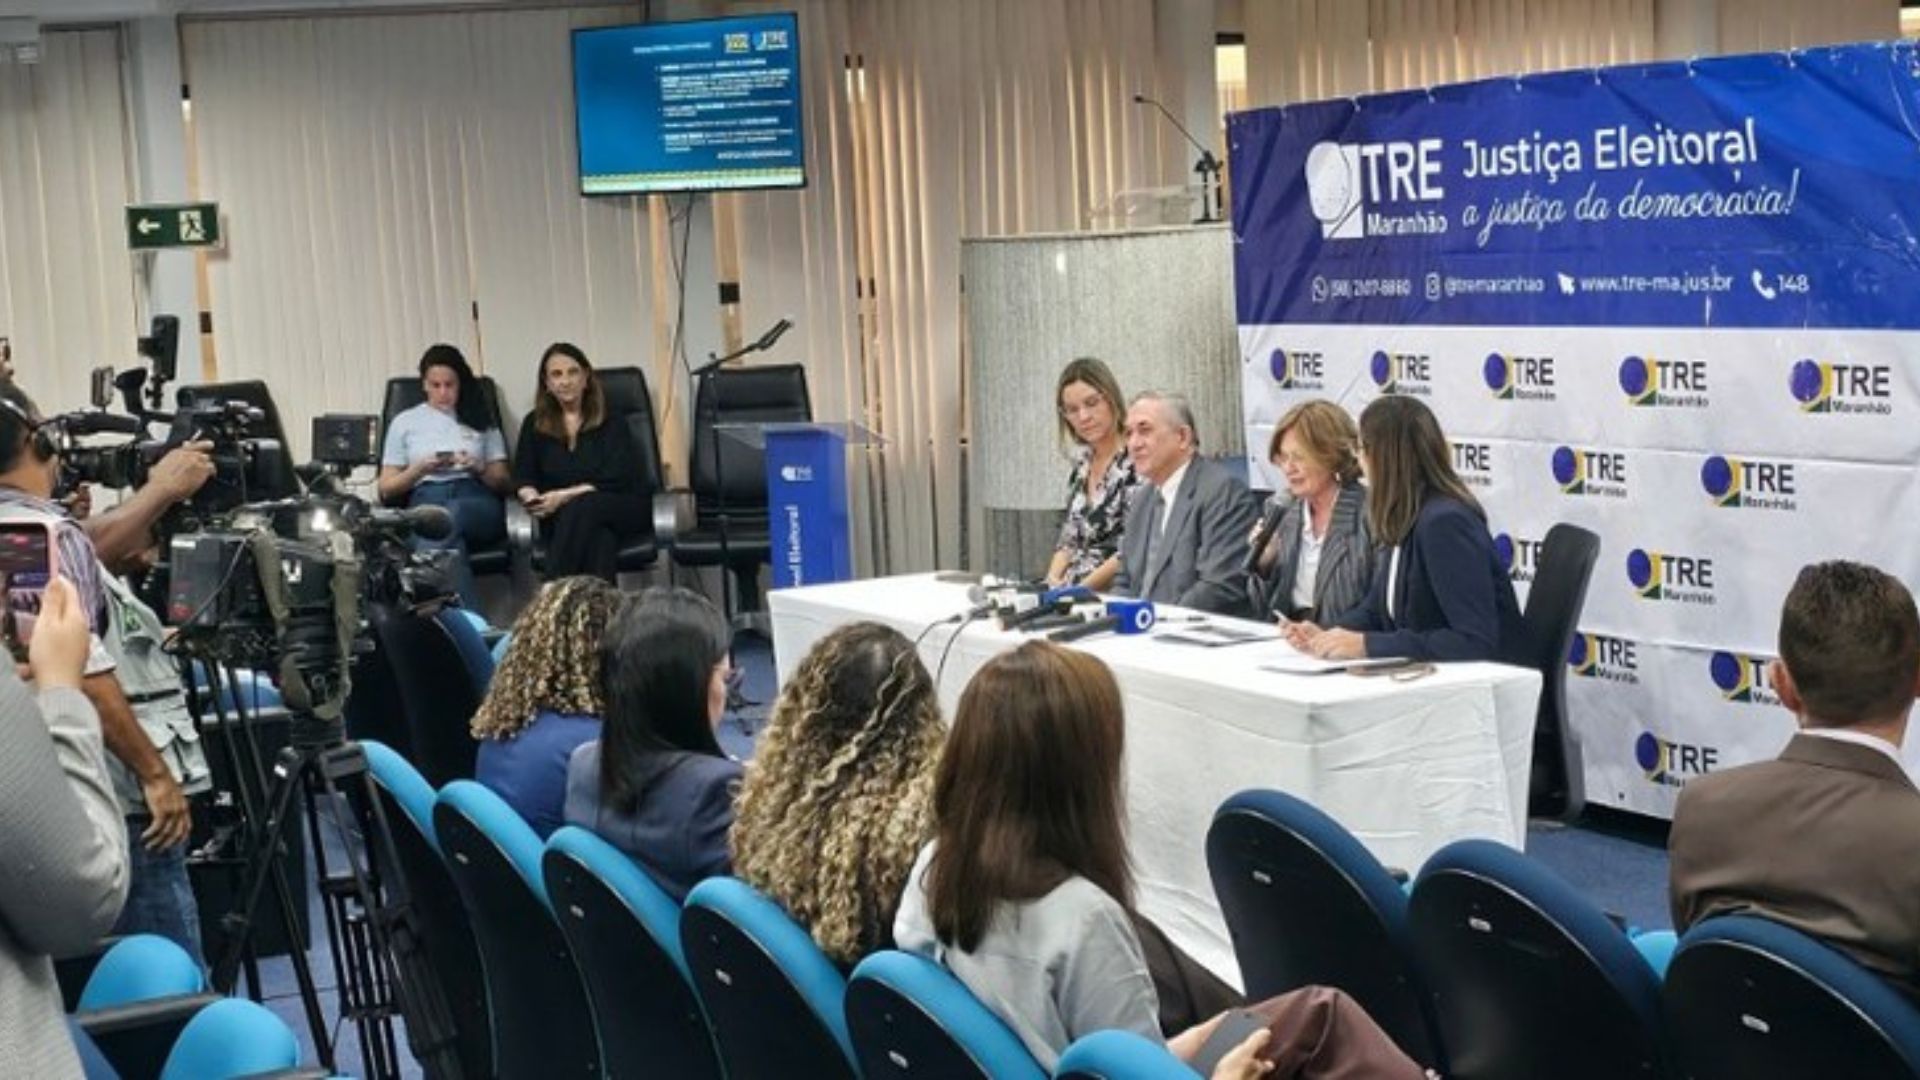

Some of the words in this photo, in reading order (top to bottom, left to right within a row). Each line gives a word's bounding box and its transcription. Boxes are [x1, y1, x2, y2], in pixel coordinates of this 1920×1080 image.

[1463, 130, 1582, 183] Justiça
[1594, 116, 1757, 170] Eleitoral
[1362, 138, 1444, 203] TRE
[1462, 205, 1480, 228] a
[1477, 190, 1566, 248] justiça
[1574, 180, 1612, 220] da
[1618, 168, 1800, 219] democracia!
[1367, 211, 1448, 236] Maranhão
[1581, 270, 1733, 294] www.tre-ma.jus.br
[1777, 274, 1810, 292] 148
[1292, 352, 1323, 377] TRE
[1395, 355, 1431, 381] TRE
[1513, 358, 1555, 386] TRE
[1656, 361, 1707, 391] TRE
[1832, 365, 1890, 397] TRE
[1453, 443, 1491, 471] TRE
[1584, 452, 1626, 483] TRE
[1741, 461, 1796, 494] TRE
[1661, 554, 1713, 588] TRE
[1595, 634, 1637, 669] TRE
